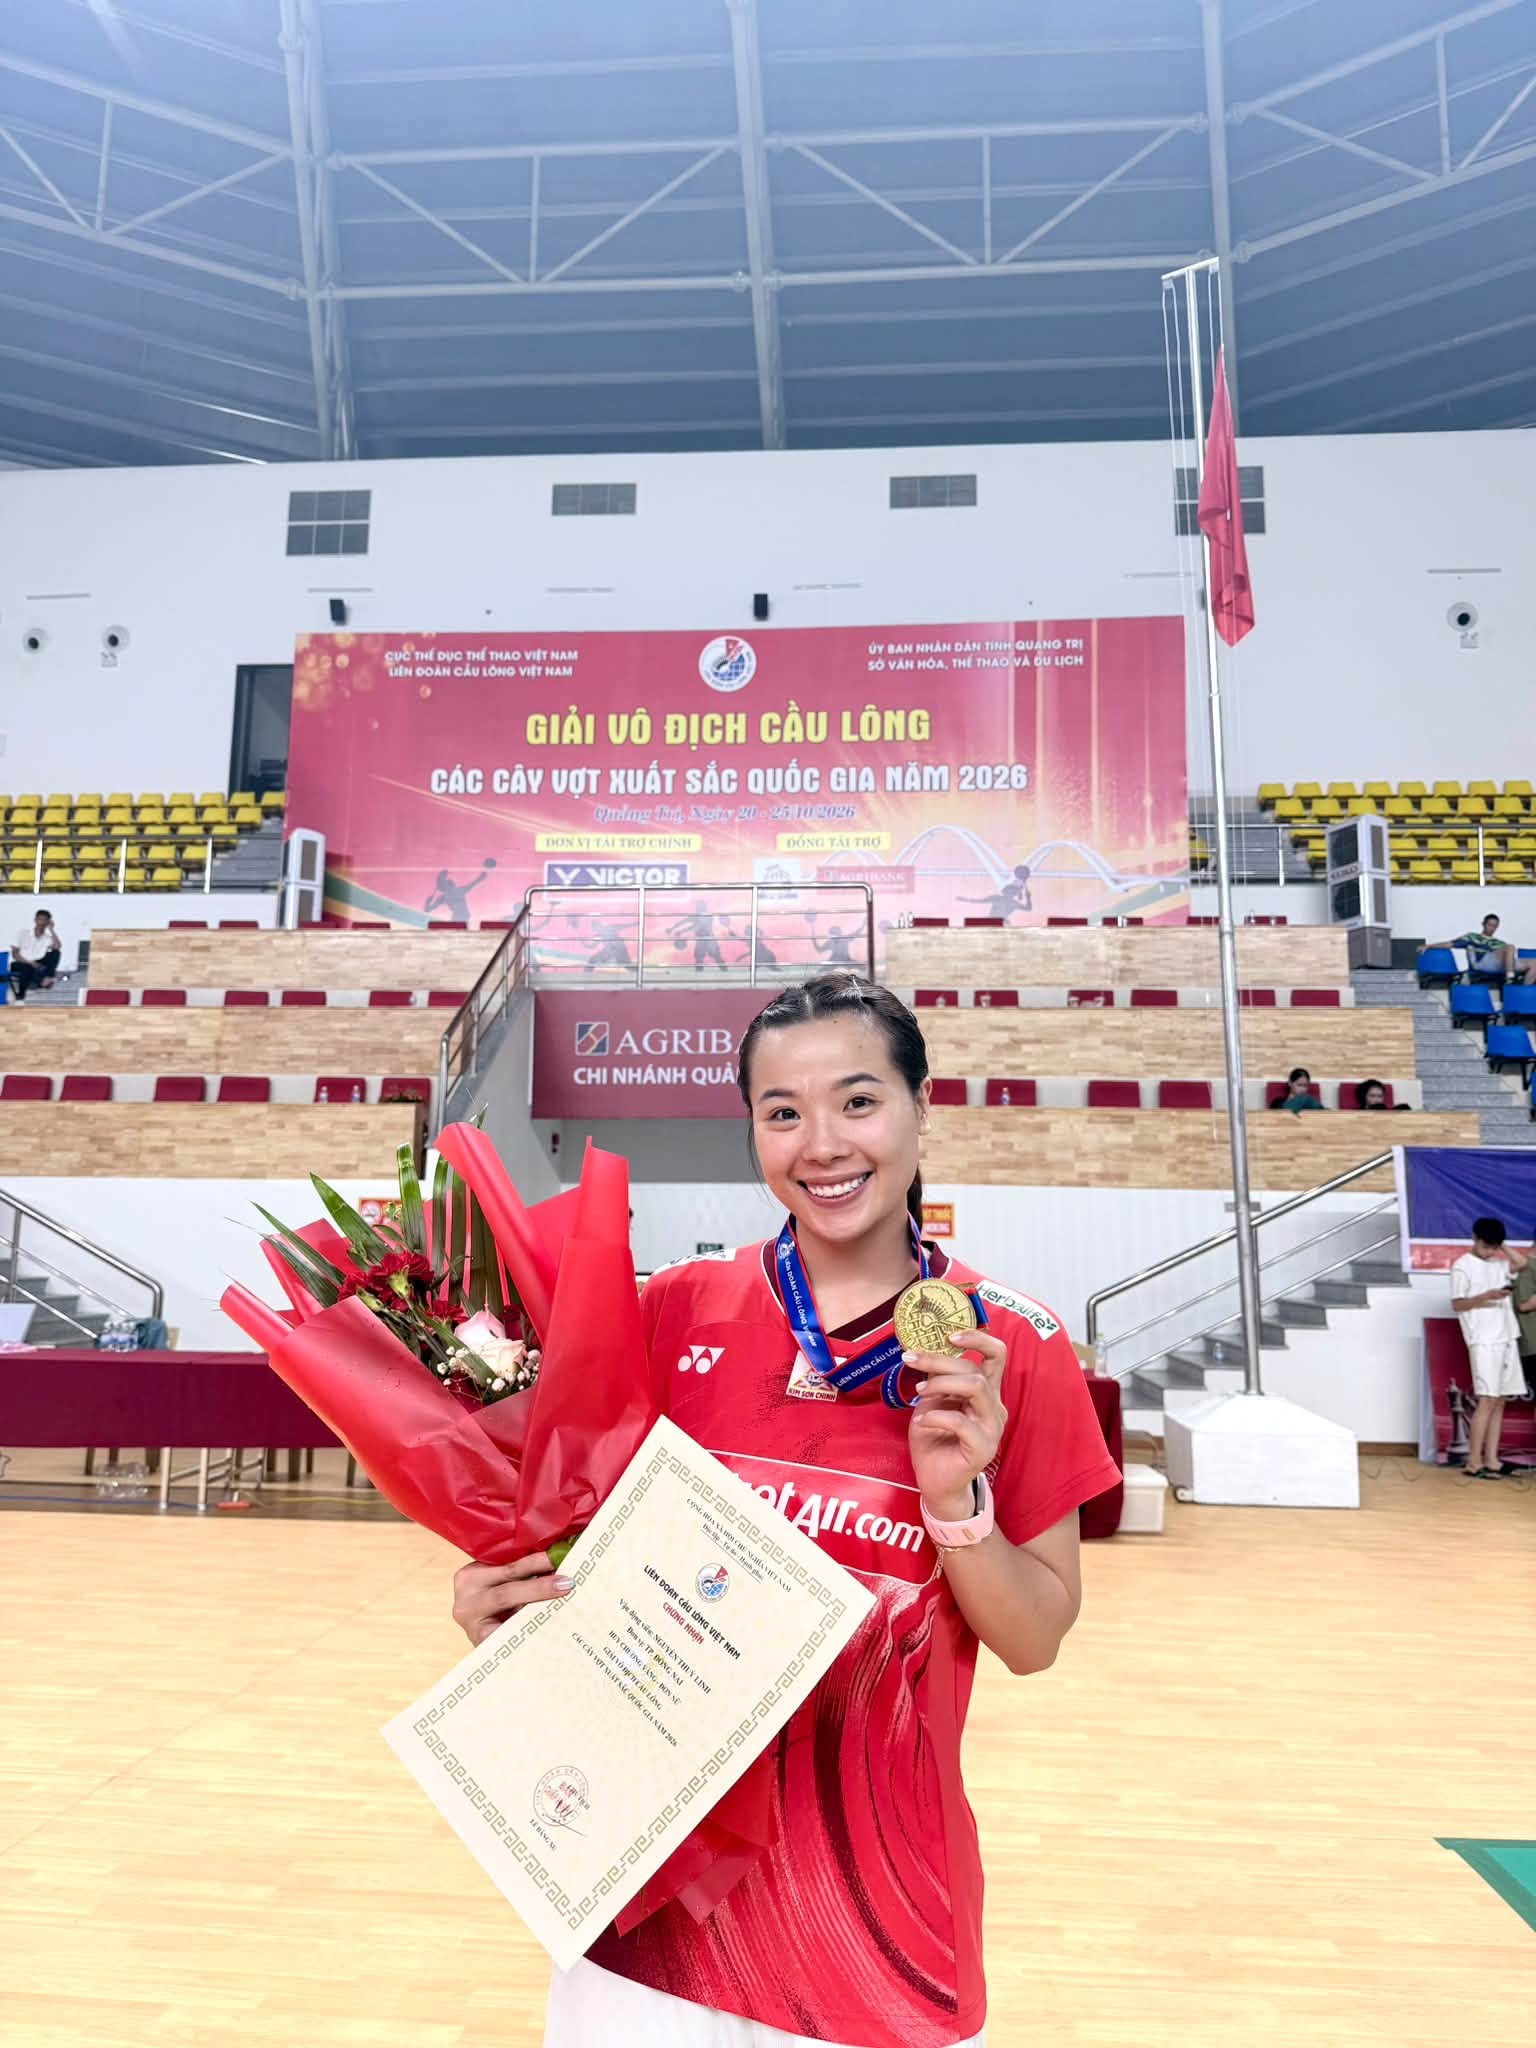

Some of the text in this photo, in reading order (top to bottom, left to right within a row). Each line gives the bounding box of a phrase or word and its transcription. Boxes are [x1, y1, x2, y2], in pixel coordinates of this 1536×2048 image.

[437, 651, 463, 662] DỤC
[467, 646, 487, 660] THỂ
[490, 651, 521, 660] THAO
[524, 648, 547, 662] VIỆT
[551, 651, 578, 660] NAM
[888, 644, 912, 654] BAN
[916, 642, 950, 653] NHÂN
[1066, 639, 1083, 652] TRỊ
[952, 655, 973, 668] THỂ
[977, 658, 1009, 667] THAO
[1014, 656, 1030, 667] VÀ
[1055, 656, 1083, 668] LỊCH
[389, 664, 412, 676] LIÊN
[454, 664, 480, 676] CẦU
[482, 664, 516, 677] LÔNG
[519, 664, 542, 678] VIỆT
[546, 667, 572, 676] NAM
[526, 700, 930, 750] GIẢI VÔ ĐỊCH CẦU LÔNG
[431, 758, 1028, 799] CÁC CÂY VỢT XUẤT SẮC QUỐC GIA NĂM 2026
[594, 804, 649, 823] Quảng
[689, 806, 732, 824] Ngày
[738, 806, 756, 819] 20
[649, 836, 692, 848] CHÍNH
[787, 836, 881, 848] ĐỒNG TÀI TRỢ
[586, 868, 681, 885] VICTOR
[615, 1029, 739, 1056] AGRIB
[574, 1062, 736, 1086] CHI NHÁNH QUẢ
[643, 1564, 661, 1582] LIÊN
[708, 1626, 726, 1644] VIỆT
[722, 1641, 742, 1660] NAM
[670, 1671, 684, 1686] NAI
[693, 1675, 711, 1694] LINH
